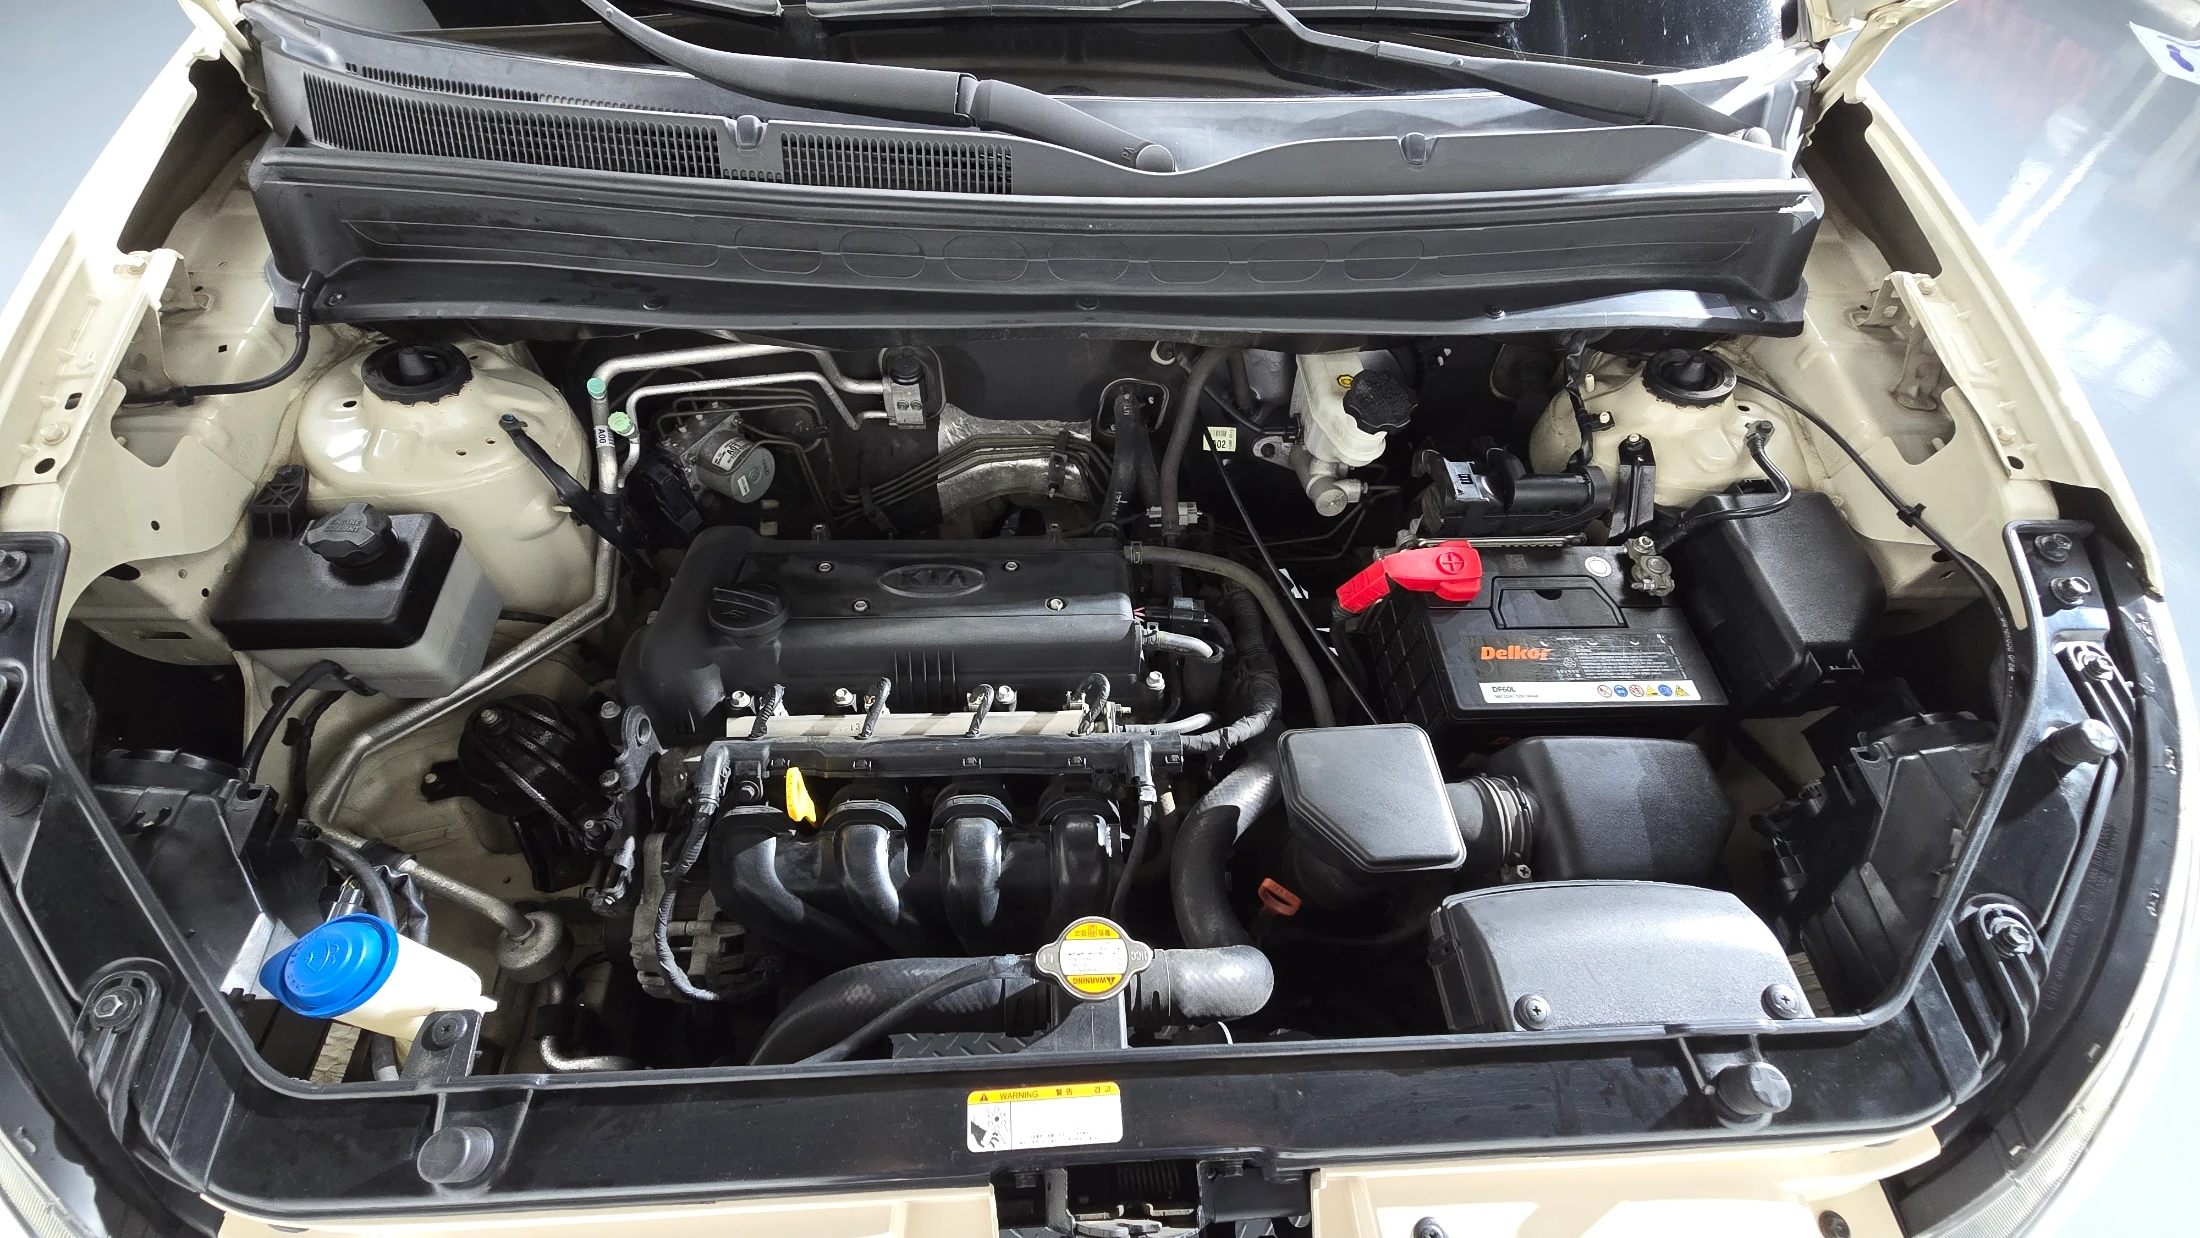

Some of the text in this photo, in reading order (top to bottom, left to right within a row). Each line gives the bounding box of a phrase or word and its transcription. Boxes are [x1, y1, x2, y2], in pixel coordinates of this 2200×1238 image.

[597, 428, 607, 444] A00
[898, 568, 969, 588] KIA
[1072, 976, 1107, 985] WARNING
[999, 1091, 1039, 1100] WARNING
